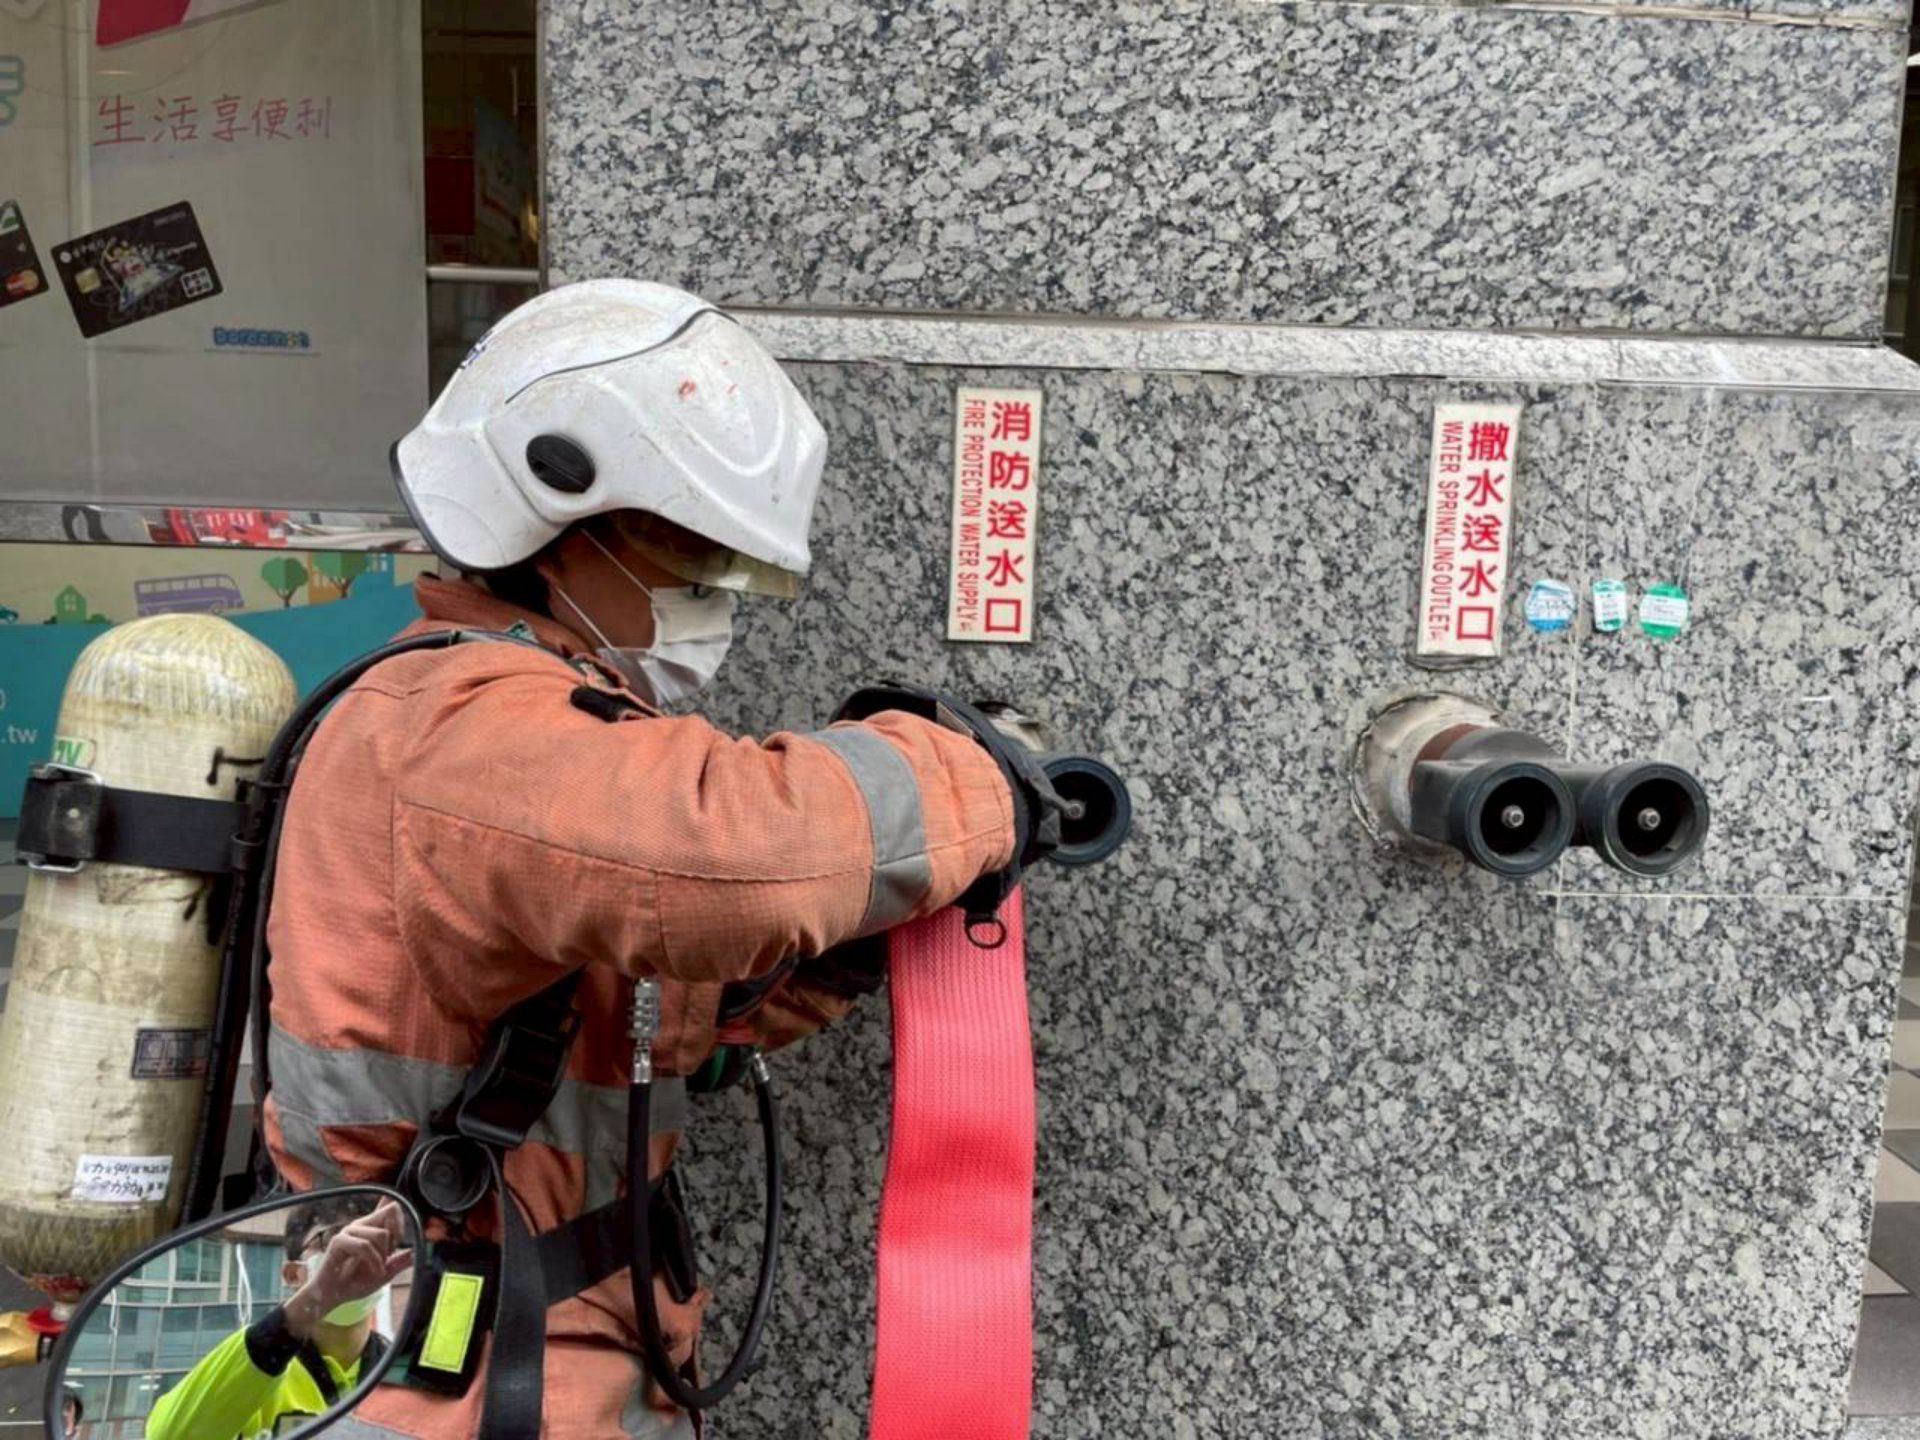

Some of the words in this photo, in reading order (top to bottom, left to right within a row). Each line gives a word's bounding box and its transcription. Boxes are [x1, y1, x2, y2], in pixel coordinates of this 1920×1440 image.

[93, 94, 332, 146] 生活享便利
[963, 399, 985, 428] FIRE
[1440, 420, 1464, 473] WATER
[960, 434, 984, 517] PROTECTION
[984, 401, 1031, 634] 消防送水口
[1456, 421, 1510, 641] 撒水送水口
[958, 523, 981, 567] WATER
[956, 572, 980, 620] SUPPLY
